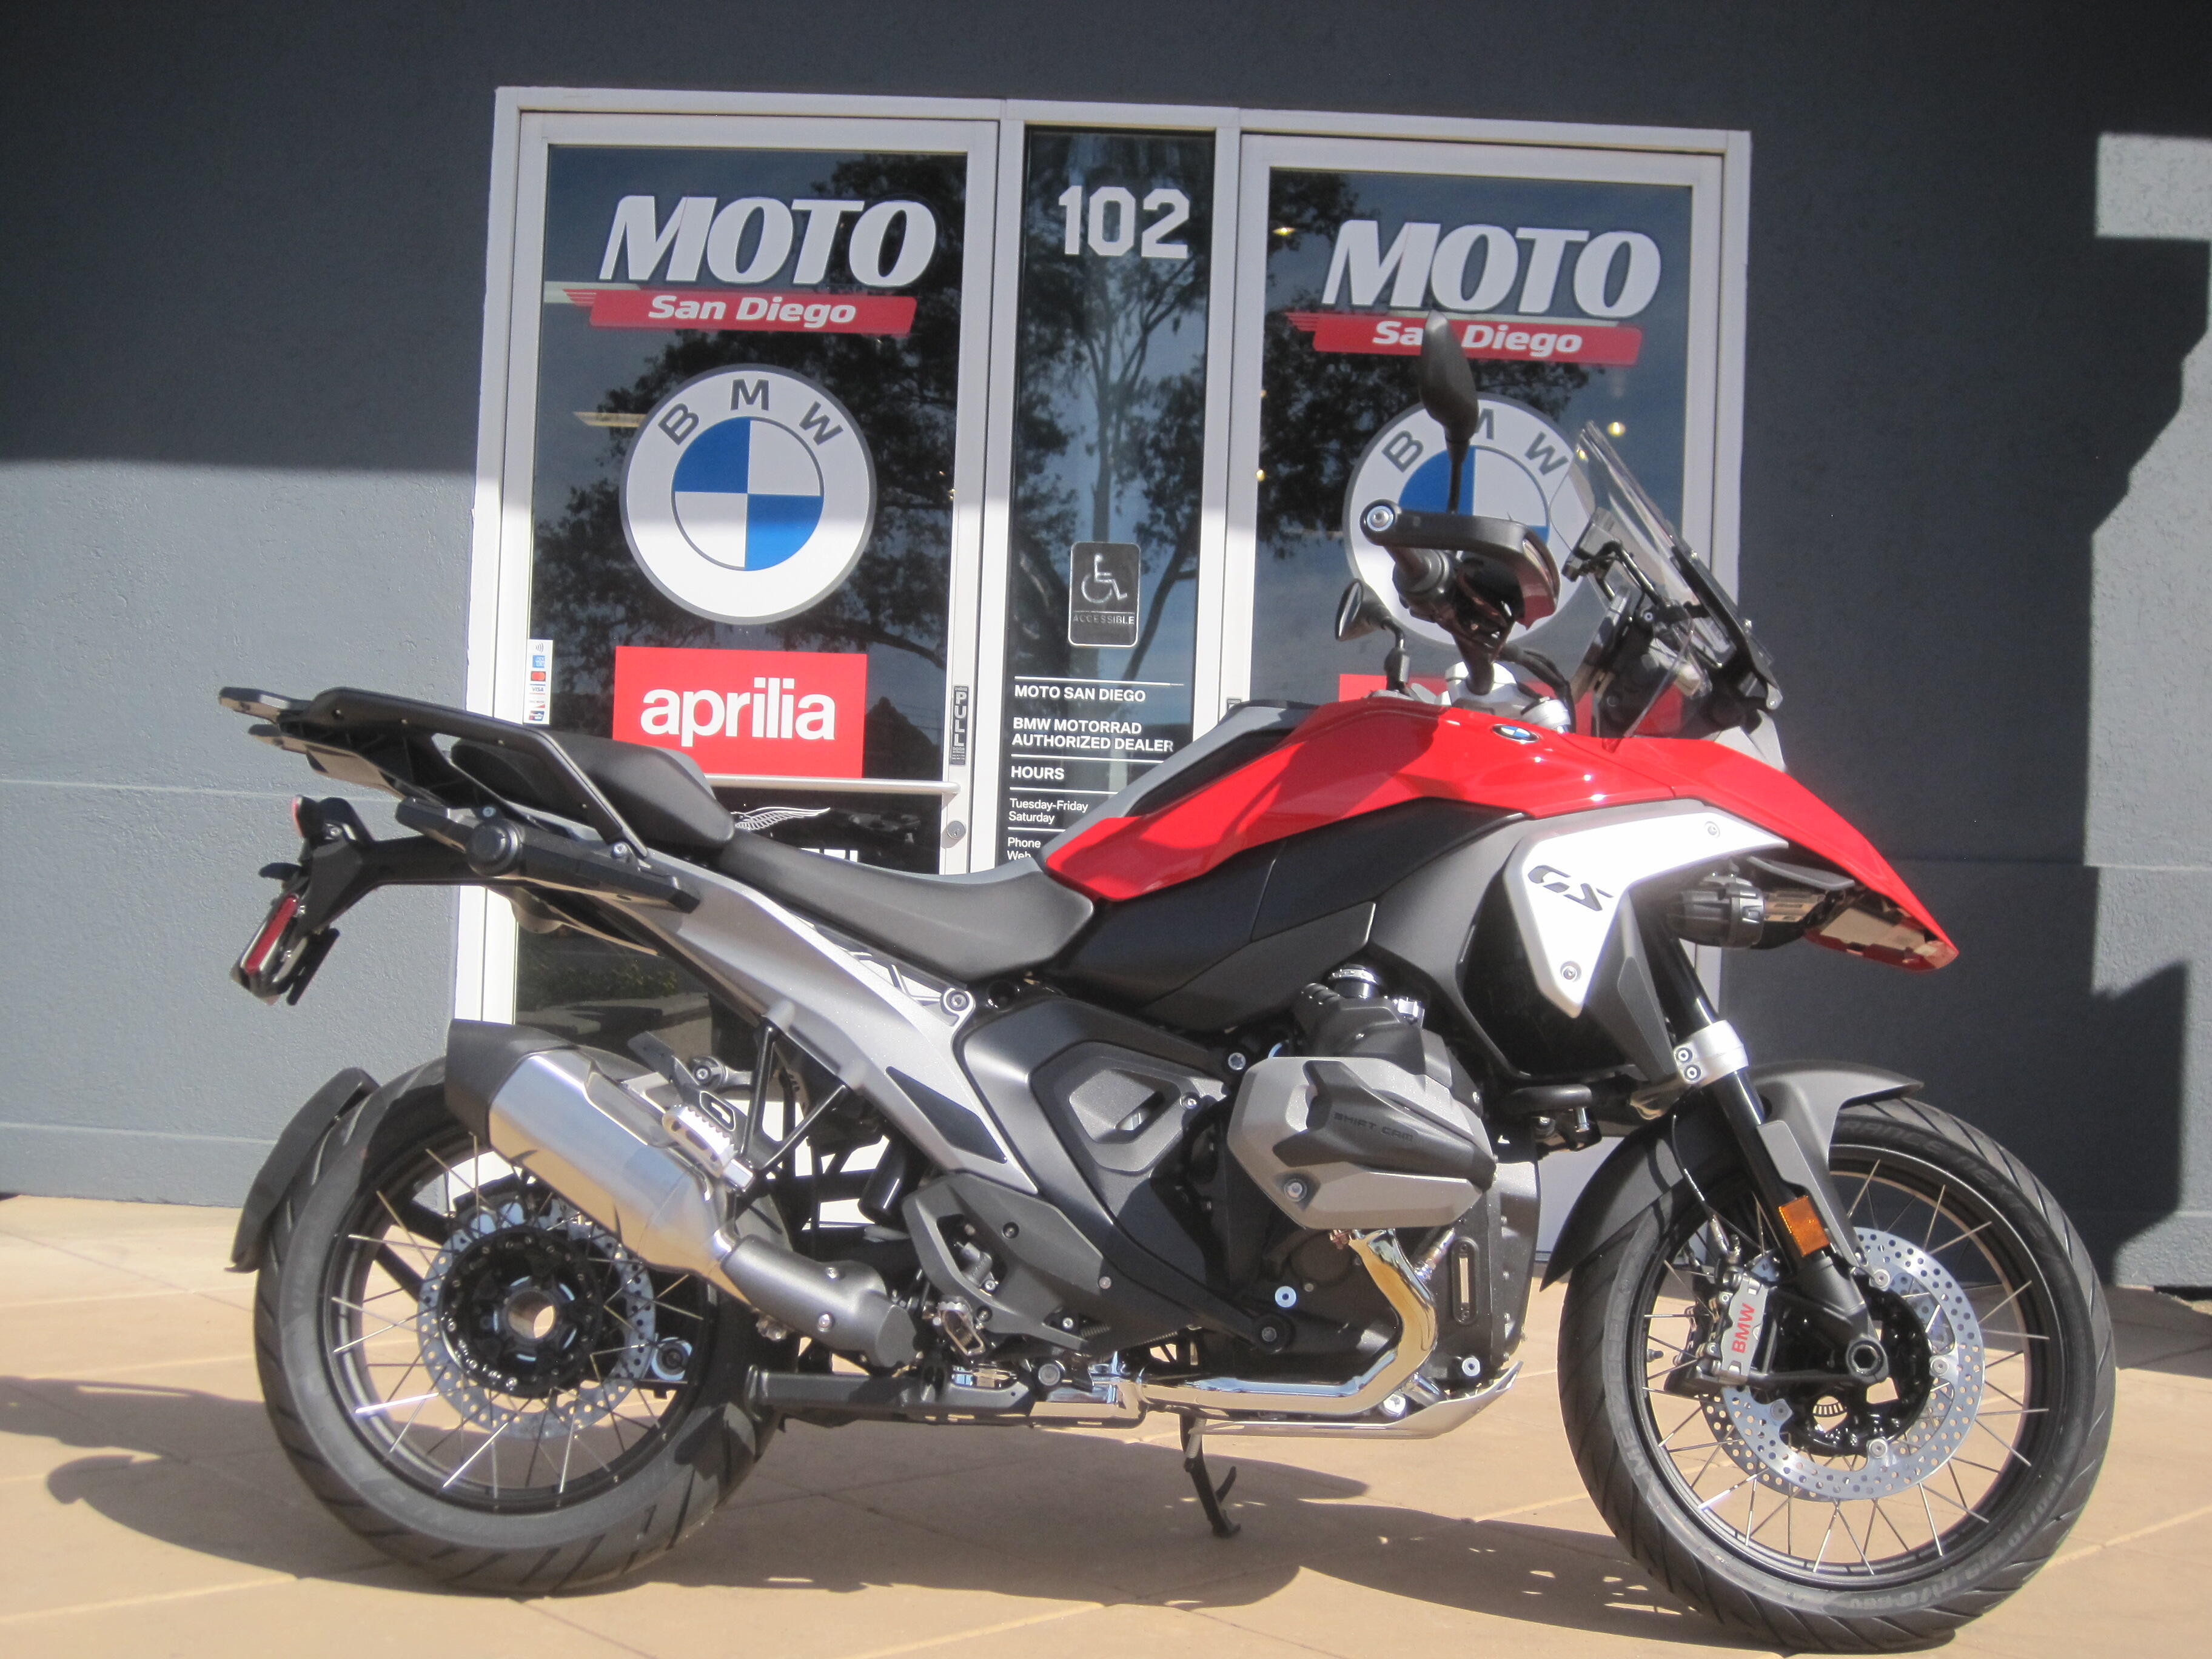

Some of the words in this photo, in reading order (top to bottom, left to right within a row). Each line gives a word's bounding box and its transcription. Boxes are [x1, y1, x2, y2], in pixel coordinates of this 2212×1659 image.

[1059, 185, 1190, 258] 102
[599, 195, 936, 287] MOTO
[1321, 220, 1661, 318] MOTO
[649, 295, 726, 320] San
[736, 297, 856, 328] Diego
[1372, 320, 1423, 346] Sa
[1461, 324, 1583, 357] Diego
[658, 378, 843, 446] BMW
[1073, 614, 1135, 625] ACCESSIBLE
[1014, 685, 1060, 698] MOTO
[1064, 687, 1094, 700] SAN
[1099, 689, 1146, 702] DIEGO
[640, 677, 836, 747] aprilia
[954, 691, 967, 746] PULL
[1013, 717, 1051, 731] BMW
[1054, 719, 1142, 734] MOTORRAD
[1011, 733, 1111, 749] AUTHORIZED
[1114, 738, 1174, 752] DEALER
[1011, 766, 1065, 780] HOURS
[1008, 811, 1055, 825] Saturday
[1010, 798, 1088, 813] Tuesday-Friday
[1007, 837, 1041, 848] Phone
[1527, 865, 1614, 911] GS
[1334, 1111, 1377, 1130] SHIFT
[1381, 1126, 1415, 1142] CAM
[1732, 1302, 1755, 1353] BMW
